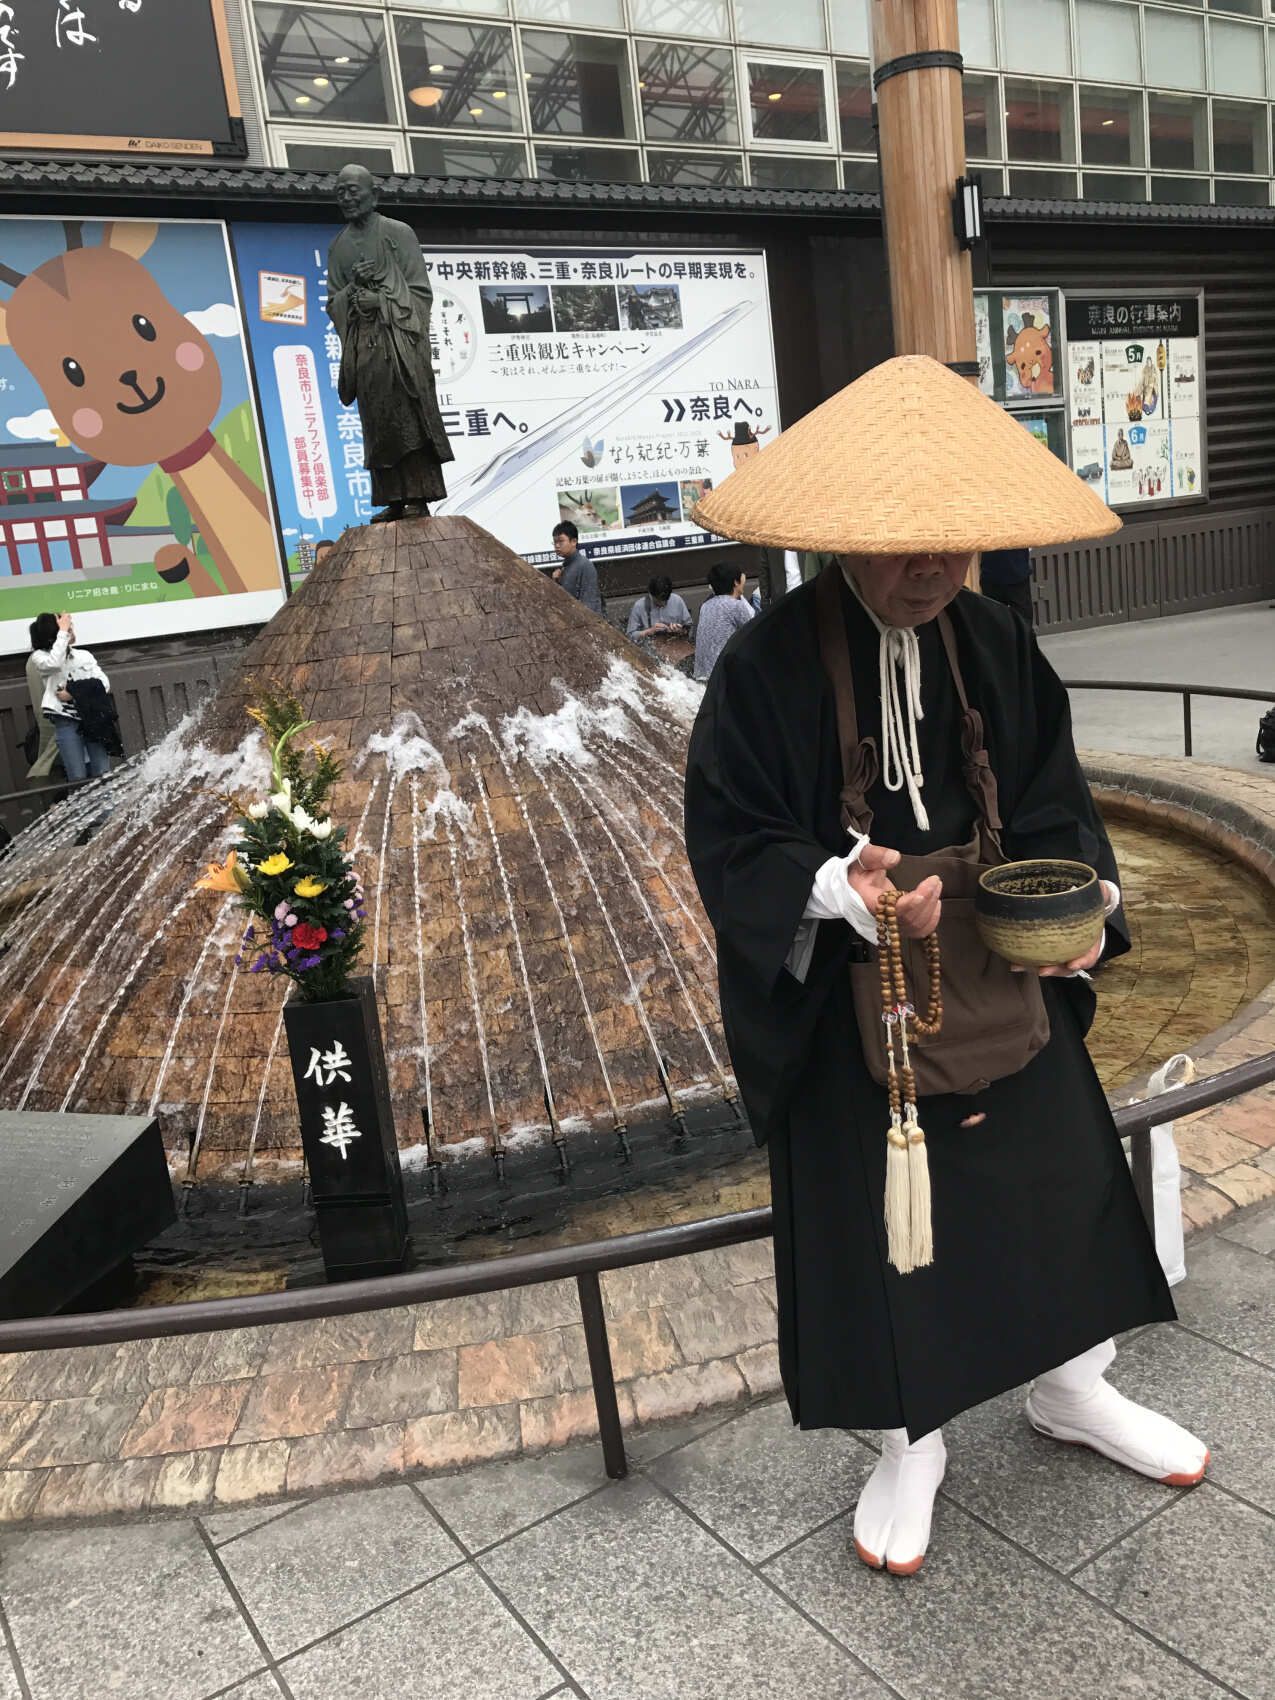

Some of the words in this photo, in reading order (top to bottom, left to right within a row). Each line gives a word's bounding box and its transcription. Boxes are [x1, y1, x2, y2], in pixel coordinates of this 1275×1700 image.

[1088, 303, 1182, 326] 奈良の行事案内
[487, 342, 652, 362] 三重県観光キャンペーン
[709, 381, 724, 392] TO
[727, 377, 760, 390] NARA
[689, 394, 763, 421] 奈良へ。
[440, 408, 529, 437] 三重へ。
[303, 1039, 362, 1160] 供華
